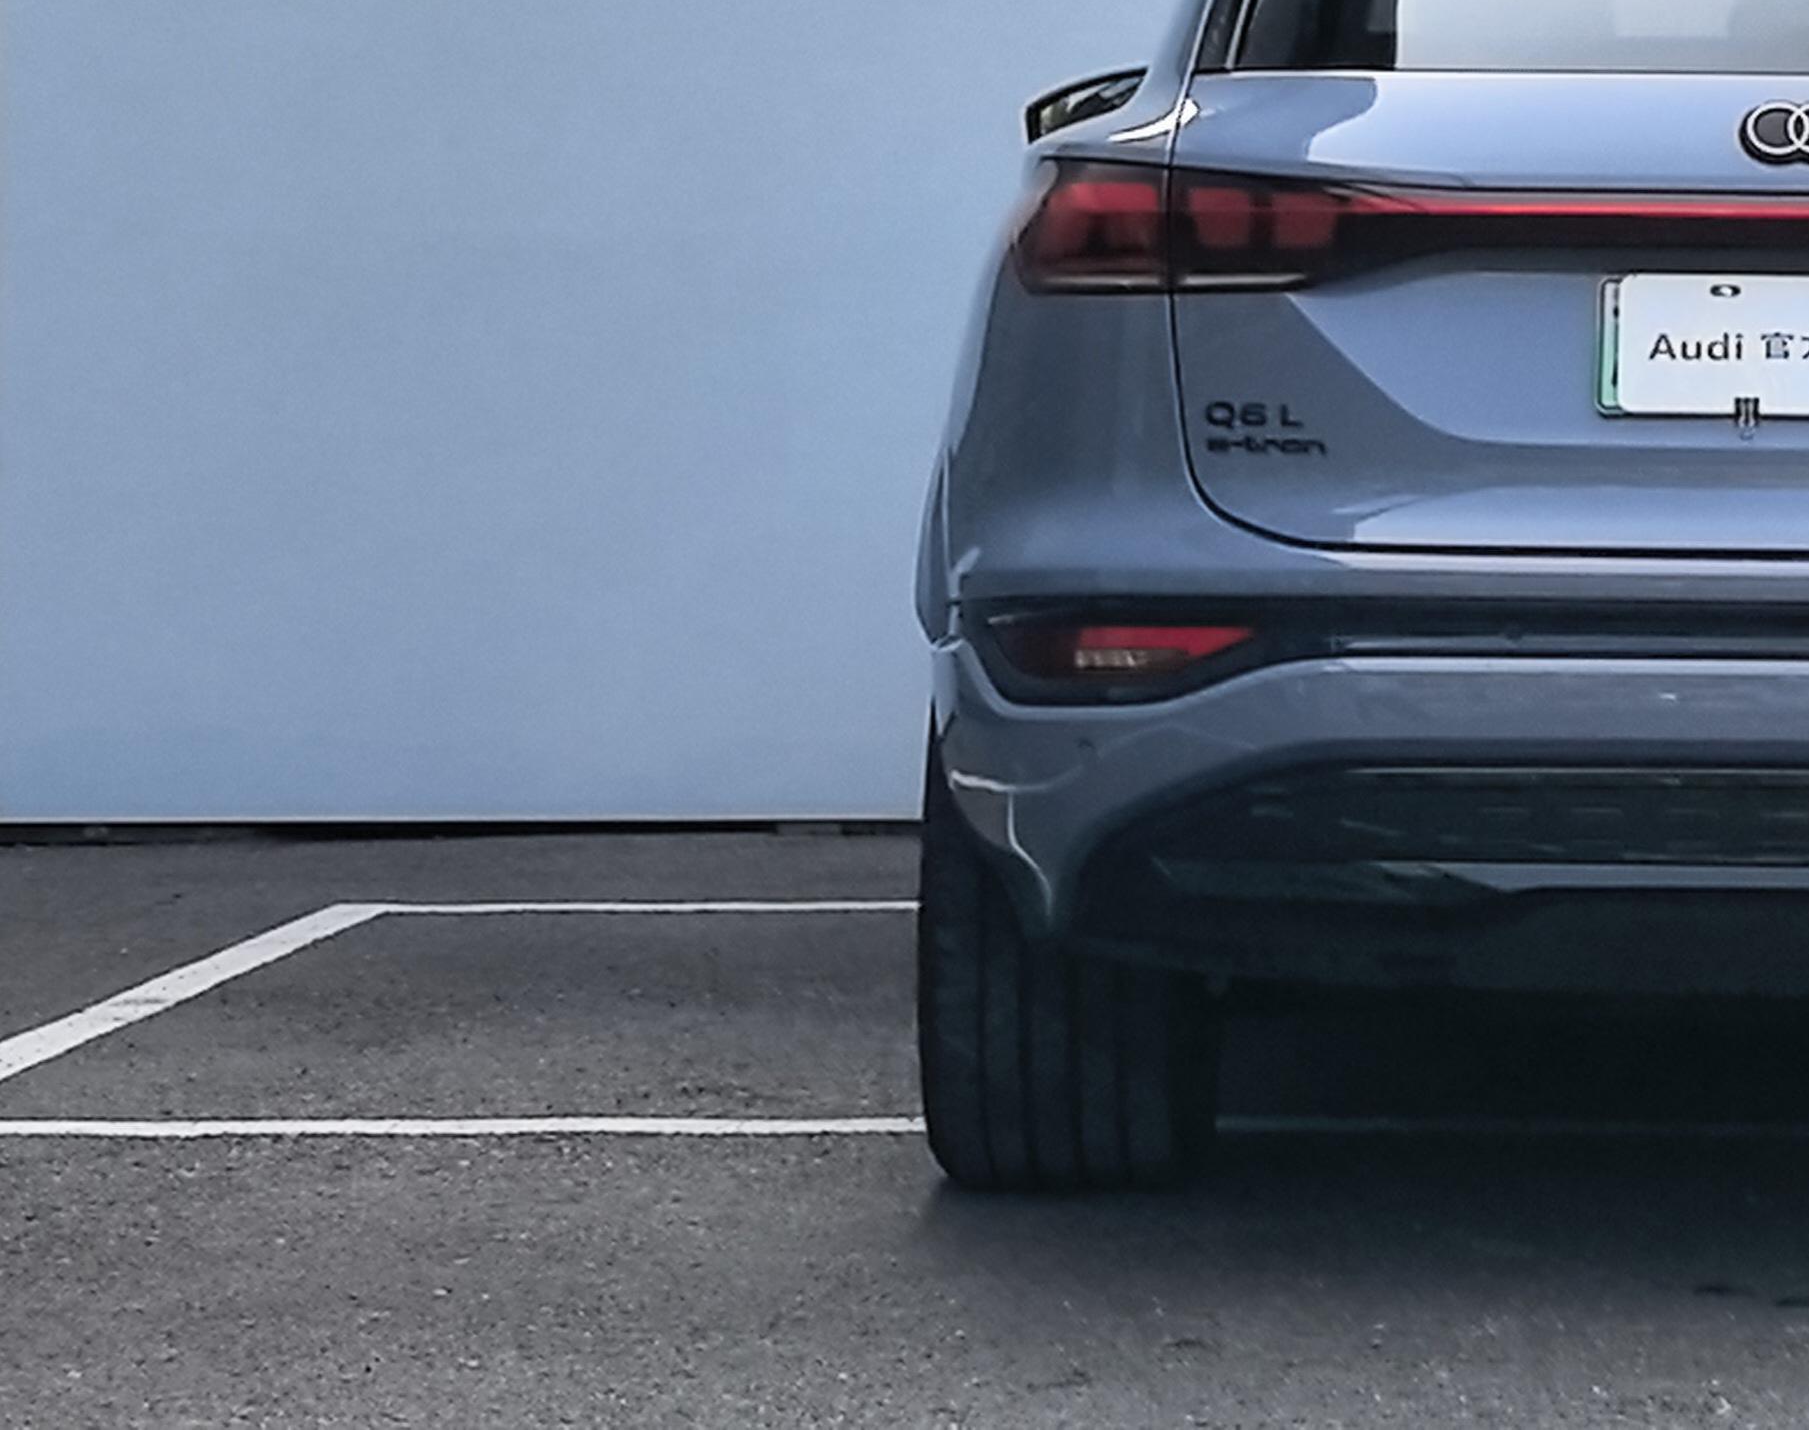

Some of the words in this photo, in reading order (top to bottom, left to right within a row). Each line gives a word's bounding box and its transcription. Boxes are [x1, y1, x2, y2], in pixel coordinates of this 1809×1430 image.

[1647, 331, 1745, 362] Audi
[1204, 400, 1268, 431] Q6
[1278, 402, 1305, 429] L
